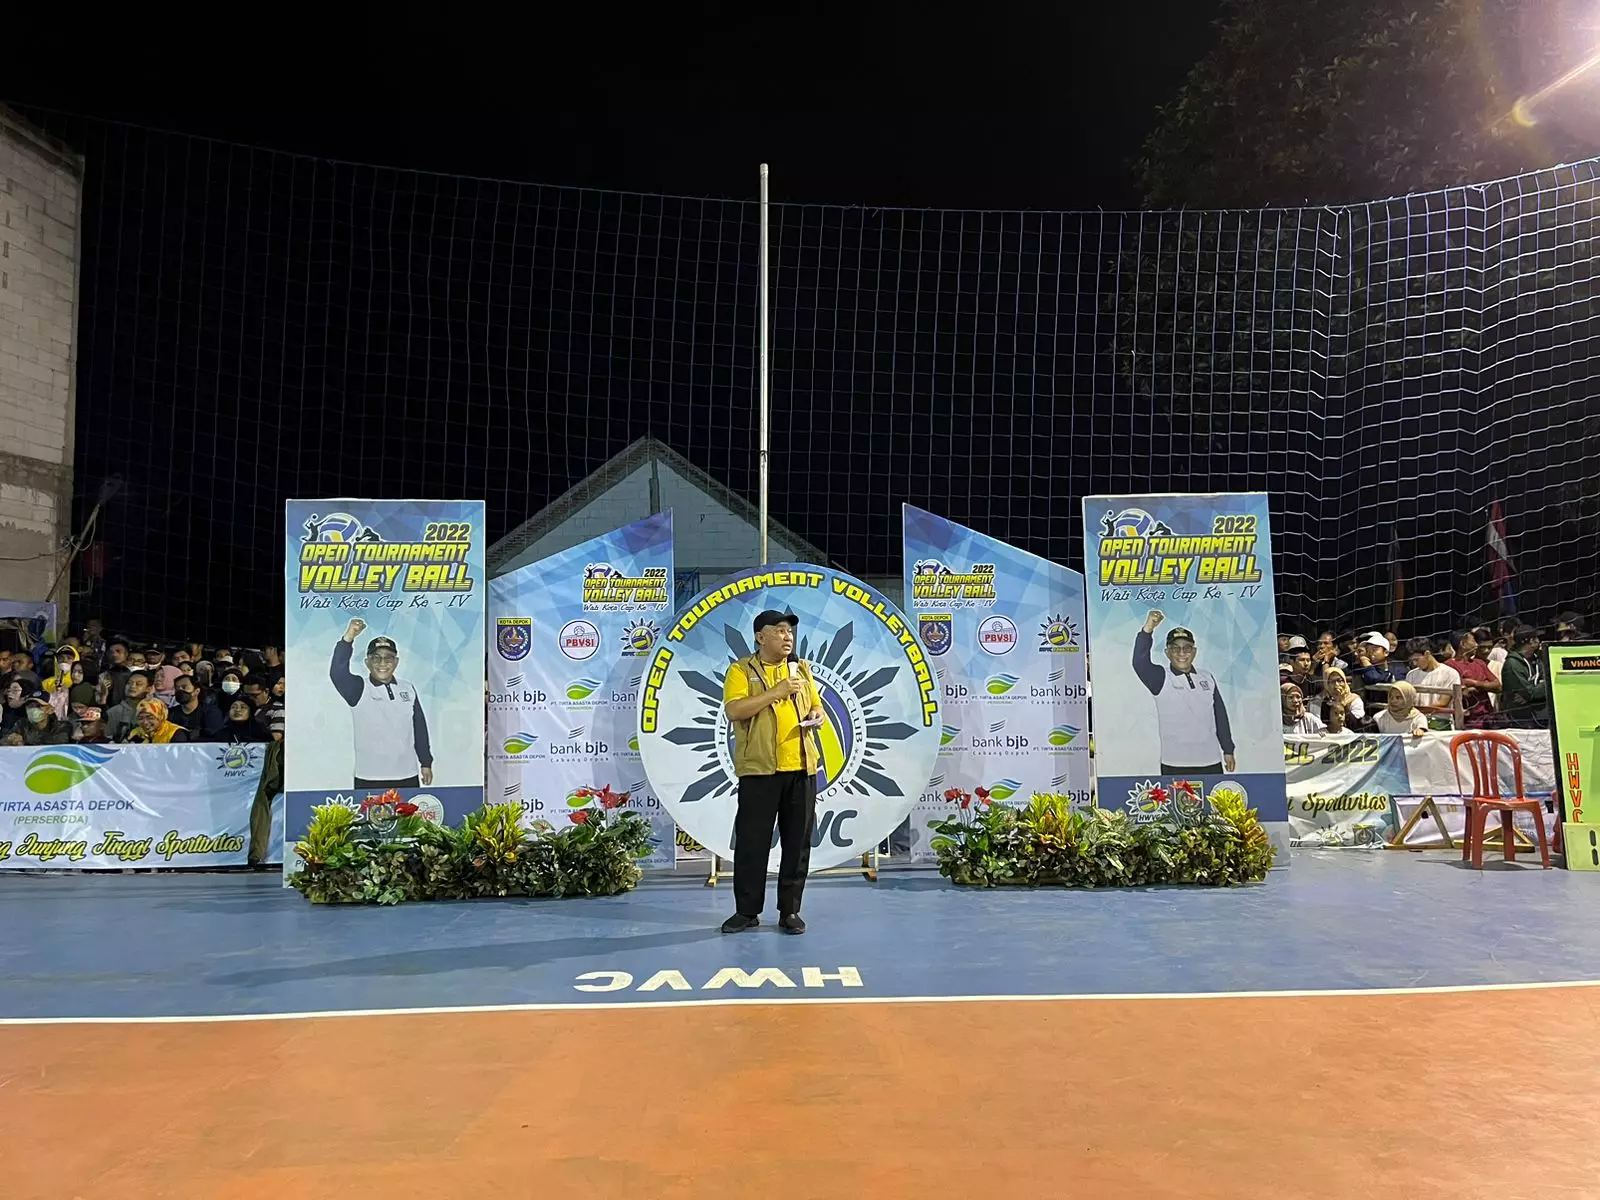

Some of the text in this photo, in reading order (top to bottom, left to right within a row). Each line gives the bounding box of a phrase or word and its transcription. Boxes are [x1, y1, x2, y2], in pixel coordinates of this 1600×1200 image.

[1214, 517, 1256, 533] 2022
[425, 524, 471, 541] 2022
[301, 543, 470, 563] OPEN TOURNAMENT
[1100, 536, 1257, 556] OPEN TOURNAMENT
[644, 569, 666, 577] 2022
[972, 565, 994, 573] 2022
[1099, 556, 1262, 585] VOLLEY BALL
[299, 564, 473, 592] VOLLEY BALL
[584, 578, 666, 588] OPEN TOURNAMENT
[914, 574, 994, 584] OPEN TOURNAMENT
[583, 589, 668, 602] VOLLEY BALL
[914, 585, 996, 598] VOLLEY BALL
[1101, 589, 1130, 601] Wali
[1135, 588, 1165, 601] Kota
[1172, 588, 1197, 602] Cup
[1203, 586, 1221, 599] Ke
[1240, 585, 1262, 598] IV
[300, 596, 333, 608] Wali
[337, 595, 369, 609] Kota
[376, 596, 403, 611] Cup
[409, 595, 428, 608] Ke
[447, 594, 472, 607] IV
[985, 634, 1013, 642] PBVSI
[641, 571, 938, 733] OPEN TOURNAMENT VOLLEYBALL
[488, 691, 546, 704] bank bjb
[946, 685, 968, 699] bjb
[1030, 685, 1087, 699] bank bjb
[808, 663, 863, 743] OLLEY CLUB
[550, 741, 608, 756] bank bjb
[972, 736, 1029, 750] bank bjb
[647, 796, 662, 809] bj
[919, 791, 942, 802] ank
[33, 800, 84, 811] ASASTA
[88, 800, 135, 811] DEPOK
[521, 799, 544, 813] bjb
[13, 814, 88, 825] (PERSERODA)
[15, 832, 88, 861] Junjung
[92, 831, 152, 861] Tinggi
[156, 830, 246, 860] Sportivitas
[573, 966, 864, 992] HWVC
